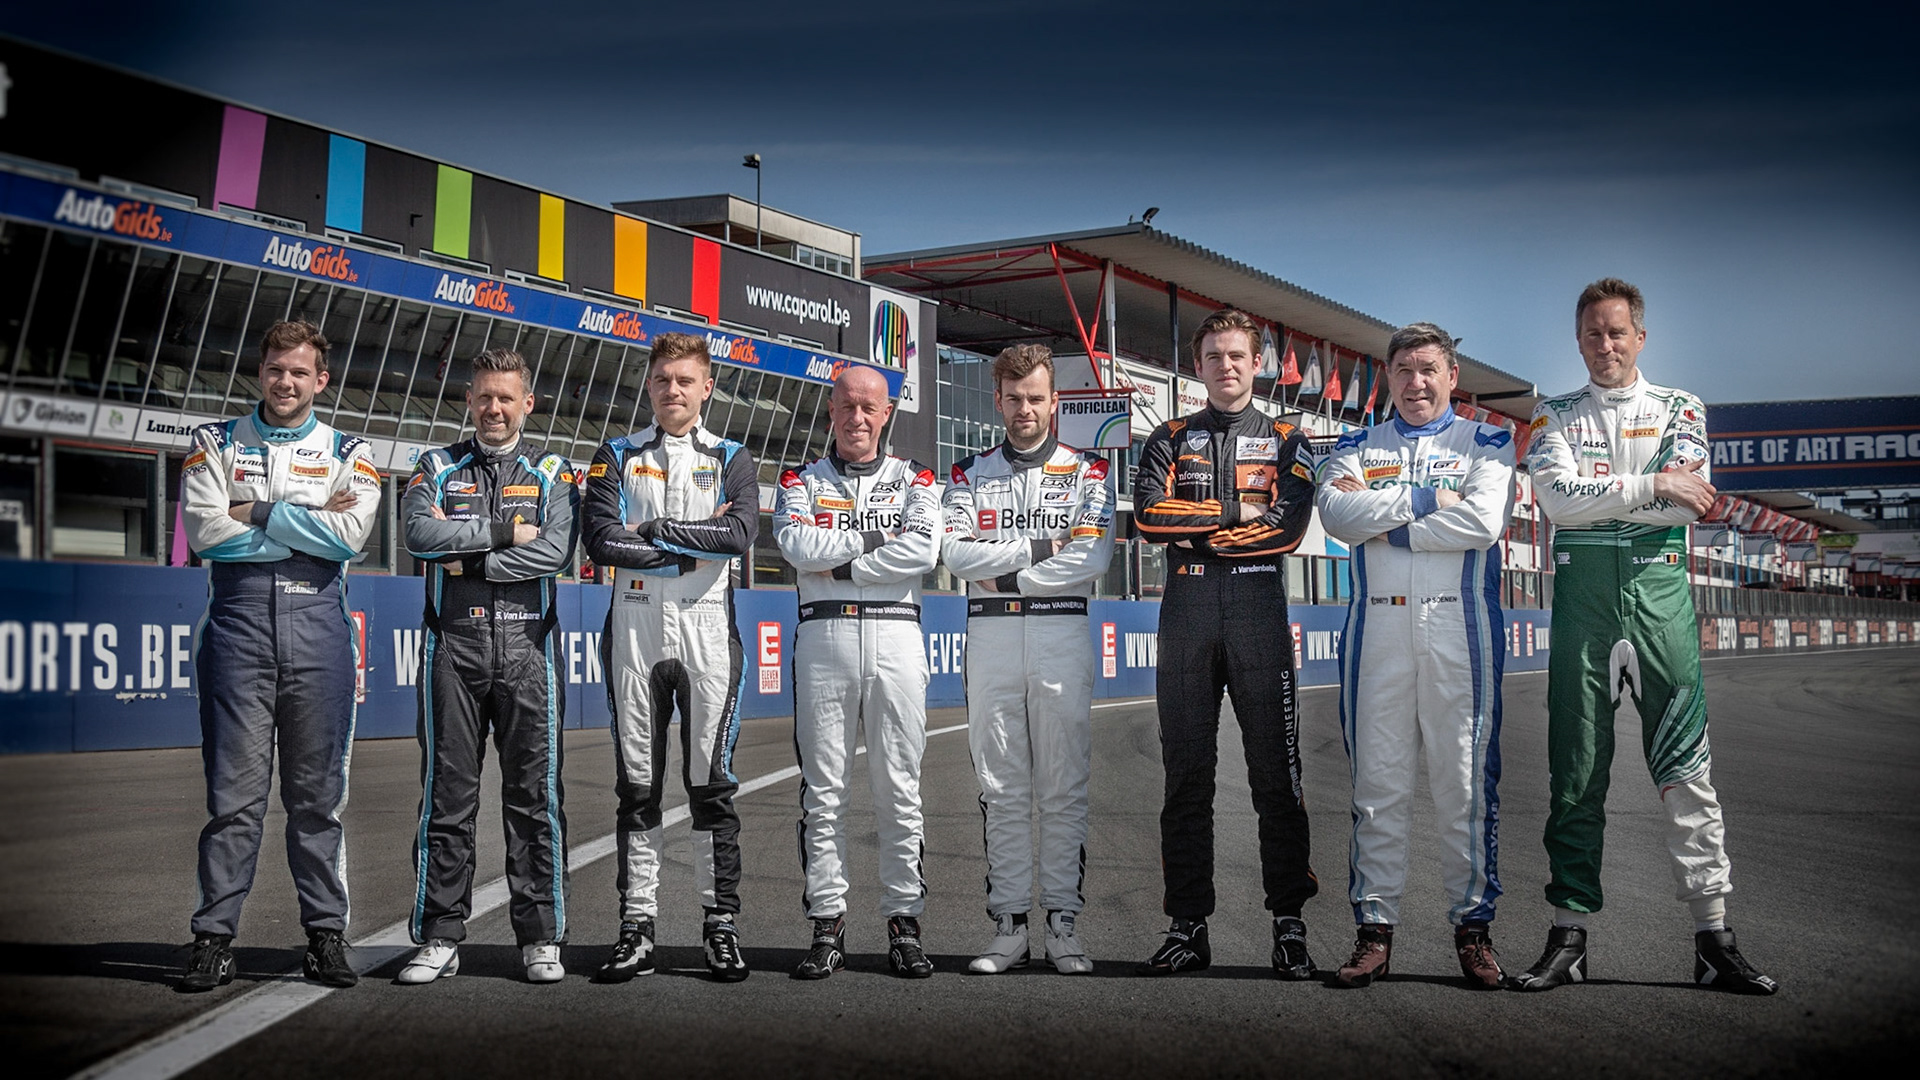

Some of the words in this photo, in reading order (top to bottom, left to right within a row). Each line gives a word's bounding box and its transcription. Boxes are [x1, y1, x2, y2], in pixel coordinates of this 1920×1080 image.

[262, 235, 359, 283] AutoGids.be
[434, 273, 515, 314] AutoGids.be
[746, 285, 851, 328] www.caparol.be
[578, 305, 648, 341] AutoGids.be
[1062, 401, 1126, 415] PROFICLEAN
[1761, 438, 1789, 463] OF
[1795, 436, 1840, 462] ART
[1002, 509, 1069, 529] Belfius
[503, 611, 518, 620] Van
[761, 681, 779, 690] SPORTS
[762, 672, 778, 680] ELEVEN
[1281, 670, 1297, 764] ENGINEERING
